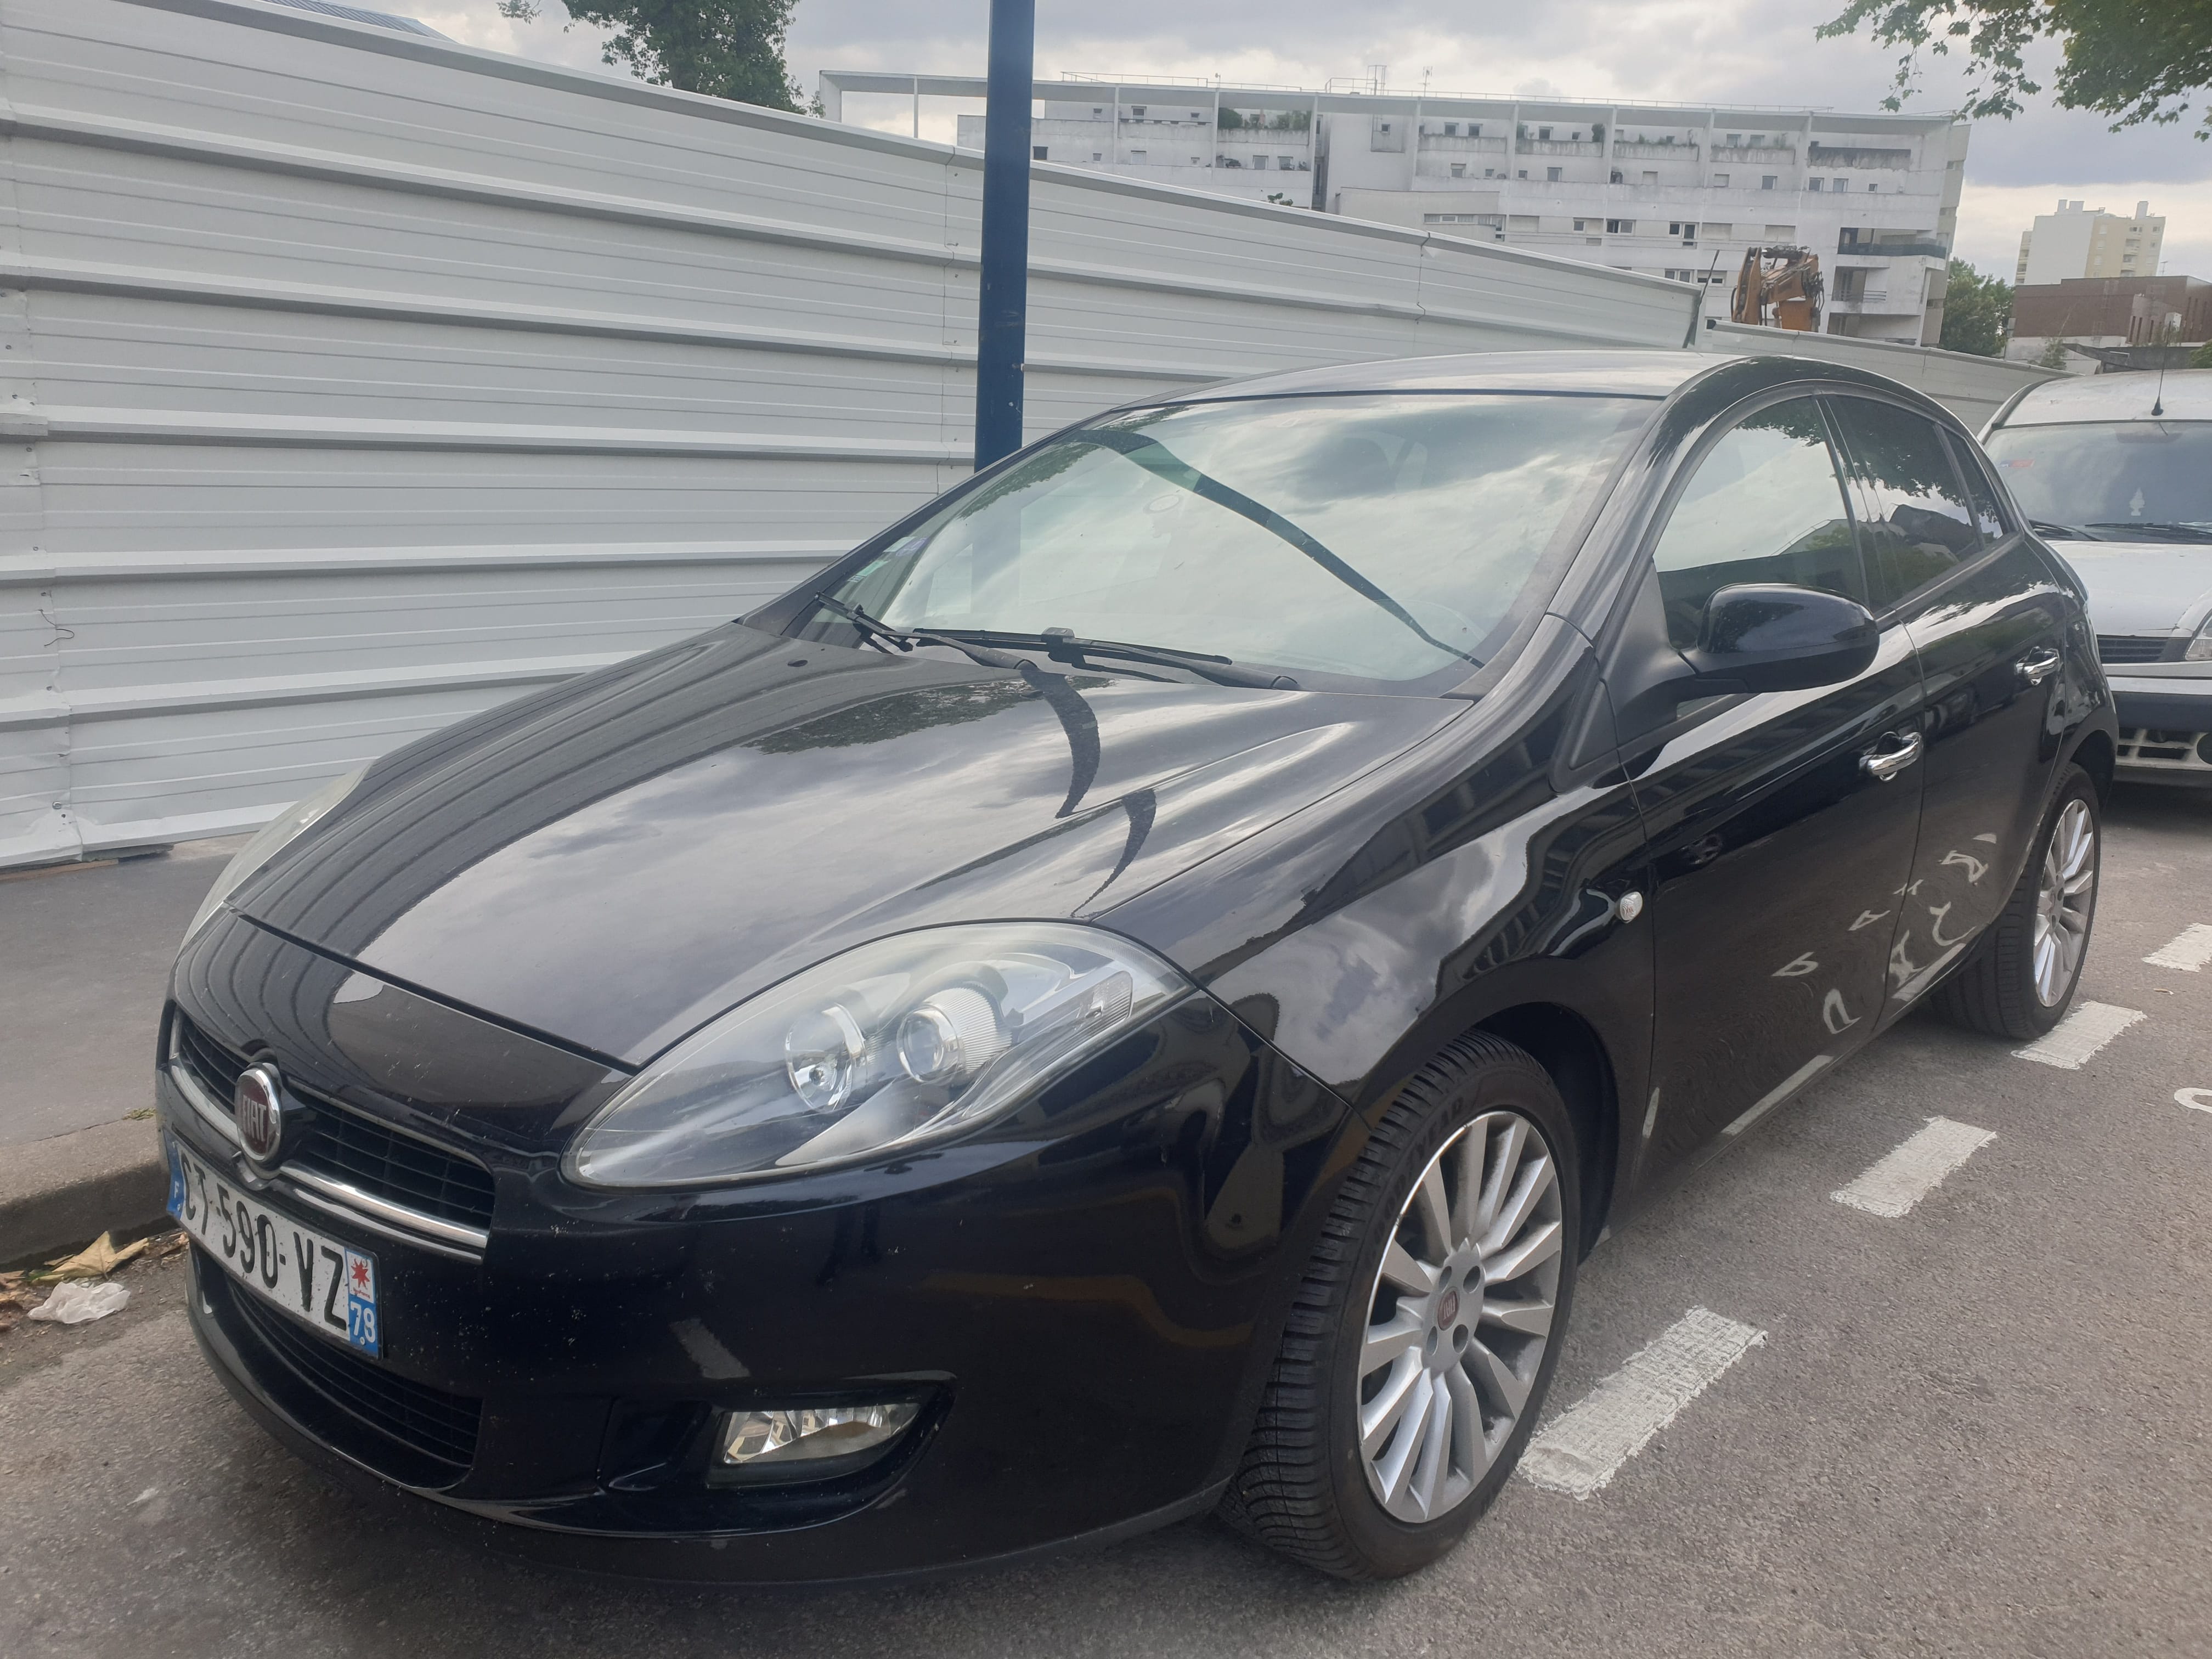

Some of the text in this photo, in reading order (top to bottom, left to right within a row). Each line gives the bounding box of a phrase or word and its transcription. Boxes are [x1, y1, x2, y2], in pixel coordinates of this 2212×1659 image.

[242, 1094, 267, 1142] FIAT
[350, 1301, 376, 1343] 78
[1443, 1294, 1455, 1321] FIAT
